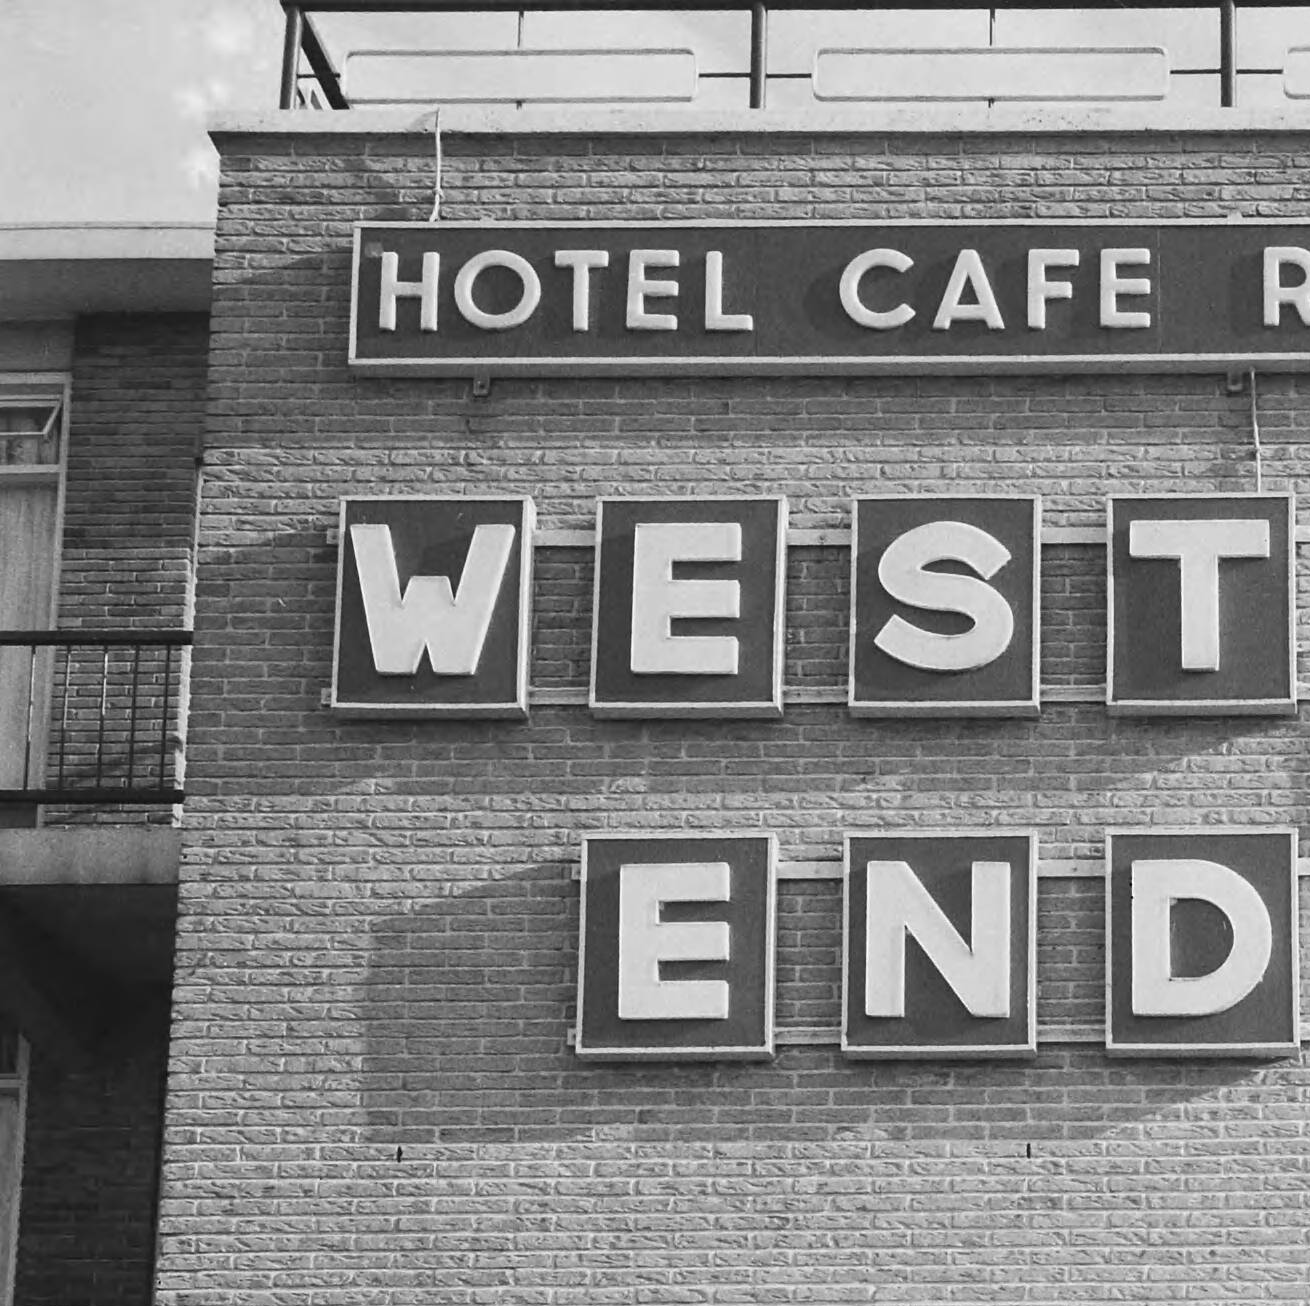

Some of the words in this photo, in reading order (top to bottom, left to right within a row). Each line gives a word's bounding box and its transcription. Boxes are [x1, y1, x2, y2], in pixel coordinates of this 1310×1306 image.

[377, 249, 755, 332] HOTEL
[838, 247, 1153, 330] CAFE
[349, 517, 1272, 676] WEST
[616, 859, 1274, 1020] END
